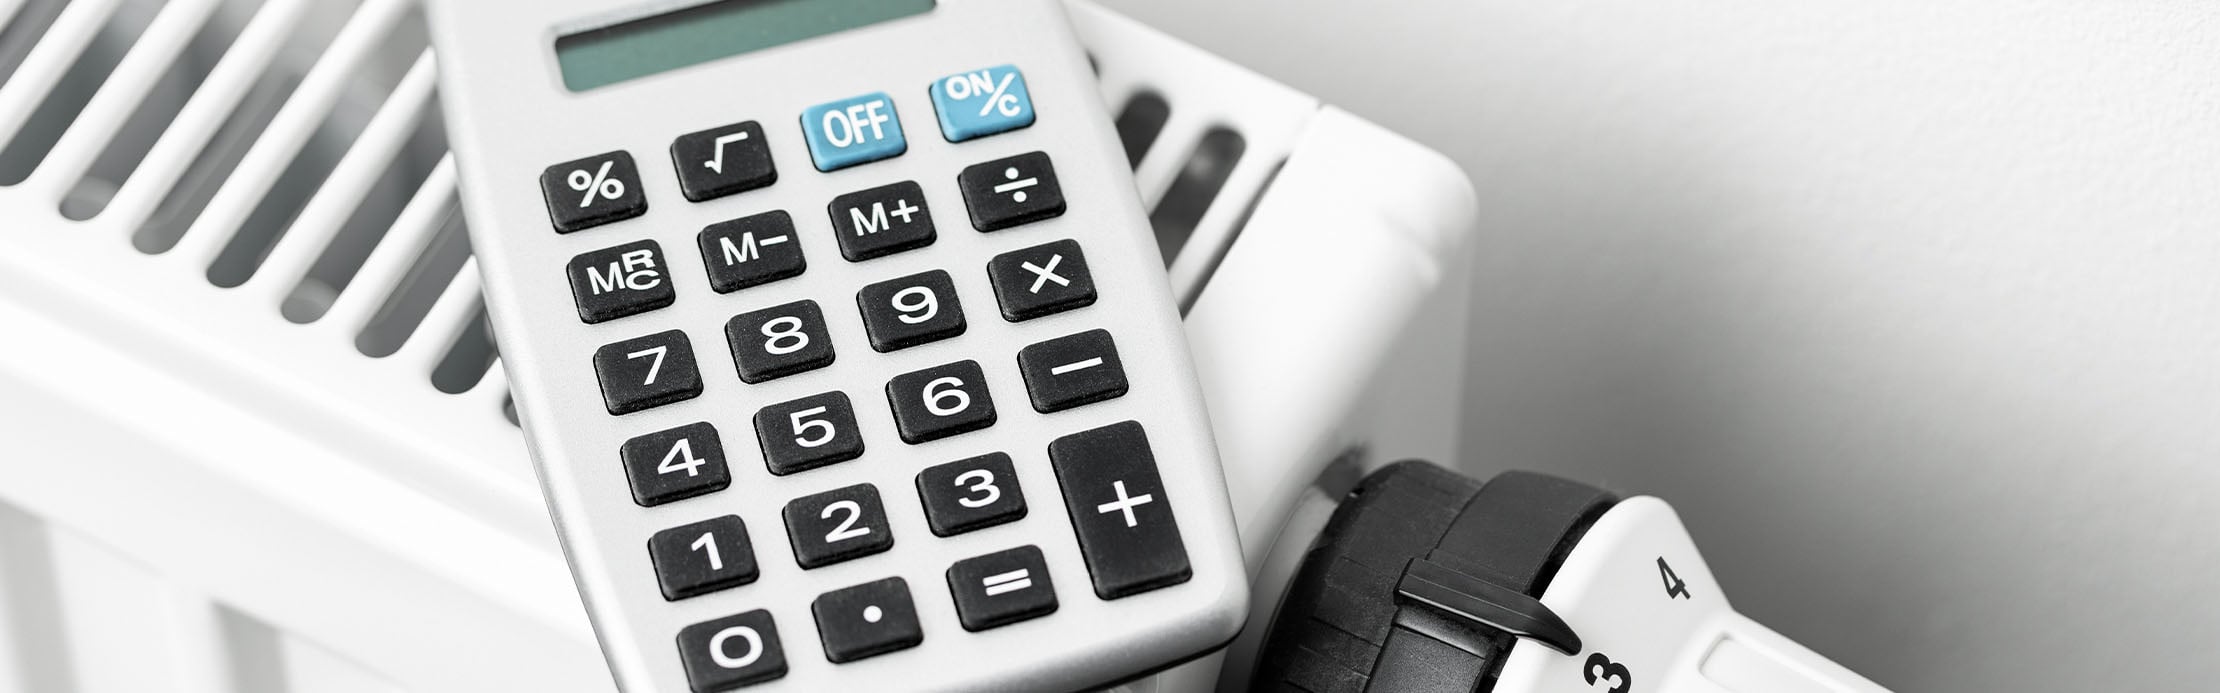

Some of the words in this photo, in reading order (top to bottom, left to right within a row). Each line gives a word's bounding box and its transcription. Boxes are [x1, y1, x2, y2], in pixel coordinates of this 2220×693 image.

[822, 99, 889, 149] OFF
[849, 198, 920, 237] M+
[891, 285, 939, 325] 9
[761, 315, 810, 356] 8
[626, 344, 668, 387] 7
[921, 375, 971, 417] 6
[789, 404, 837, 449] 5
[656, 437, 707, 478] 4
[953, 468, 1002, 509] 3
[820, 499, 871, 544] 2
[690, 531, 724, 571] 1
[1656, 556, 1691, 601] 4
[709, 625, 764, 669] 0
[1583, 651, 1632, 693] 3
